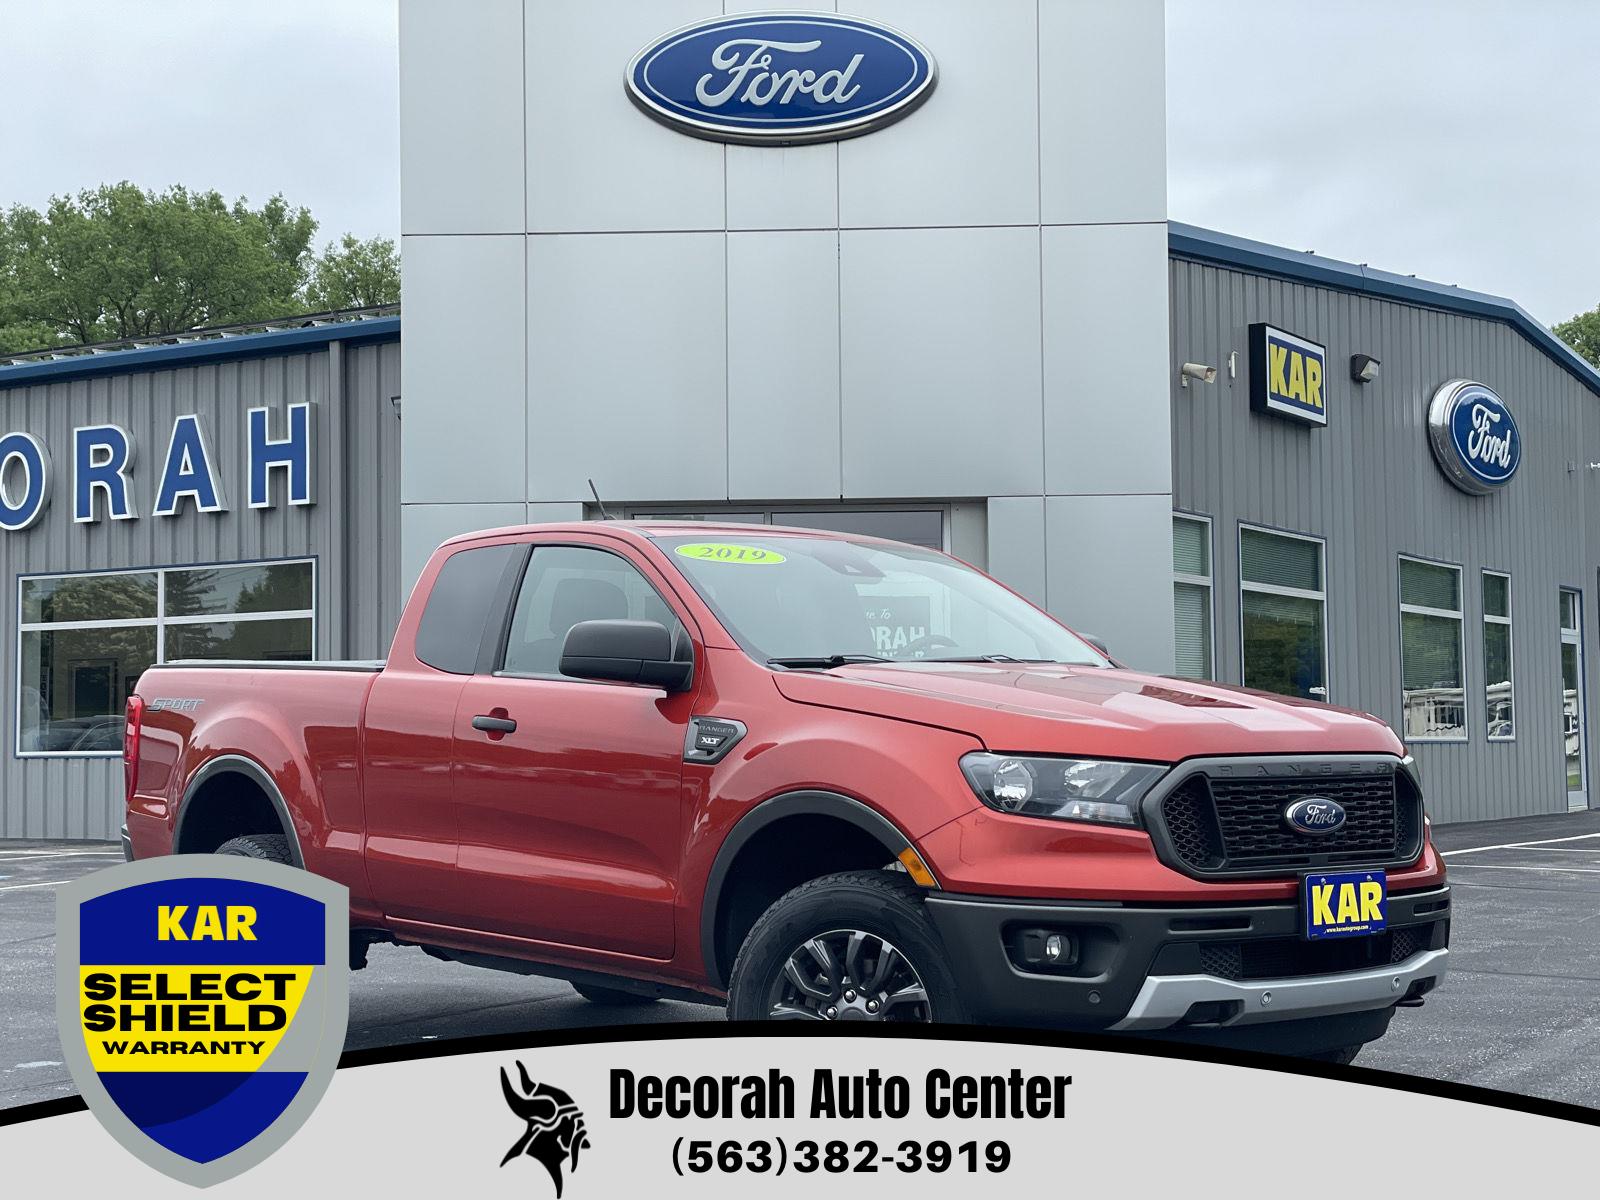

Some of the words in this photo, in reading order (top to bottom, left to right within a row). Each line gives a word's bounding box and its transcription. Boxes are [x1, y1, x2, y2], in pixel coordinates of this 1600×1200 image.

[695, 38, 865, 108] Ford
[1269, 343, 1323, 408] KAR
[1468, 402, 1511, 470] Ford
[0, 401, 316, 531] ORAH
[698, 547, 767, 560] 2019
[870, 626, 925, 650] RAH
[146, 698, 205, 711] SPORT
[701, 736, 720, 744] XLT
[1218, 762, 1394, 777] RANGER
[1305, 804, 1337, 825] Ford
[1312, 881, 1383, 926] KAR
